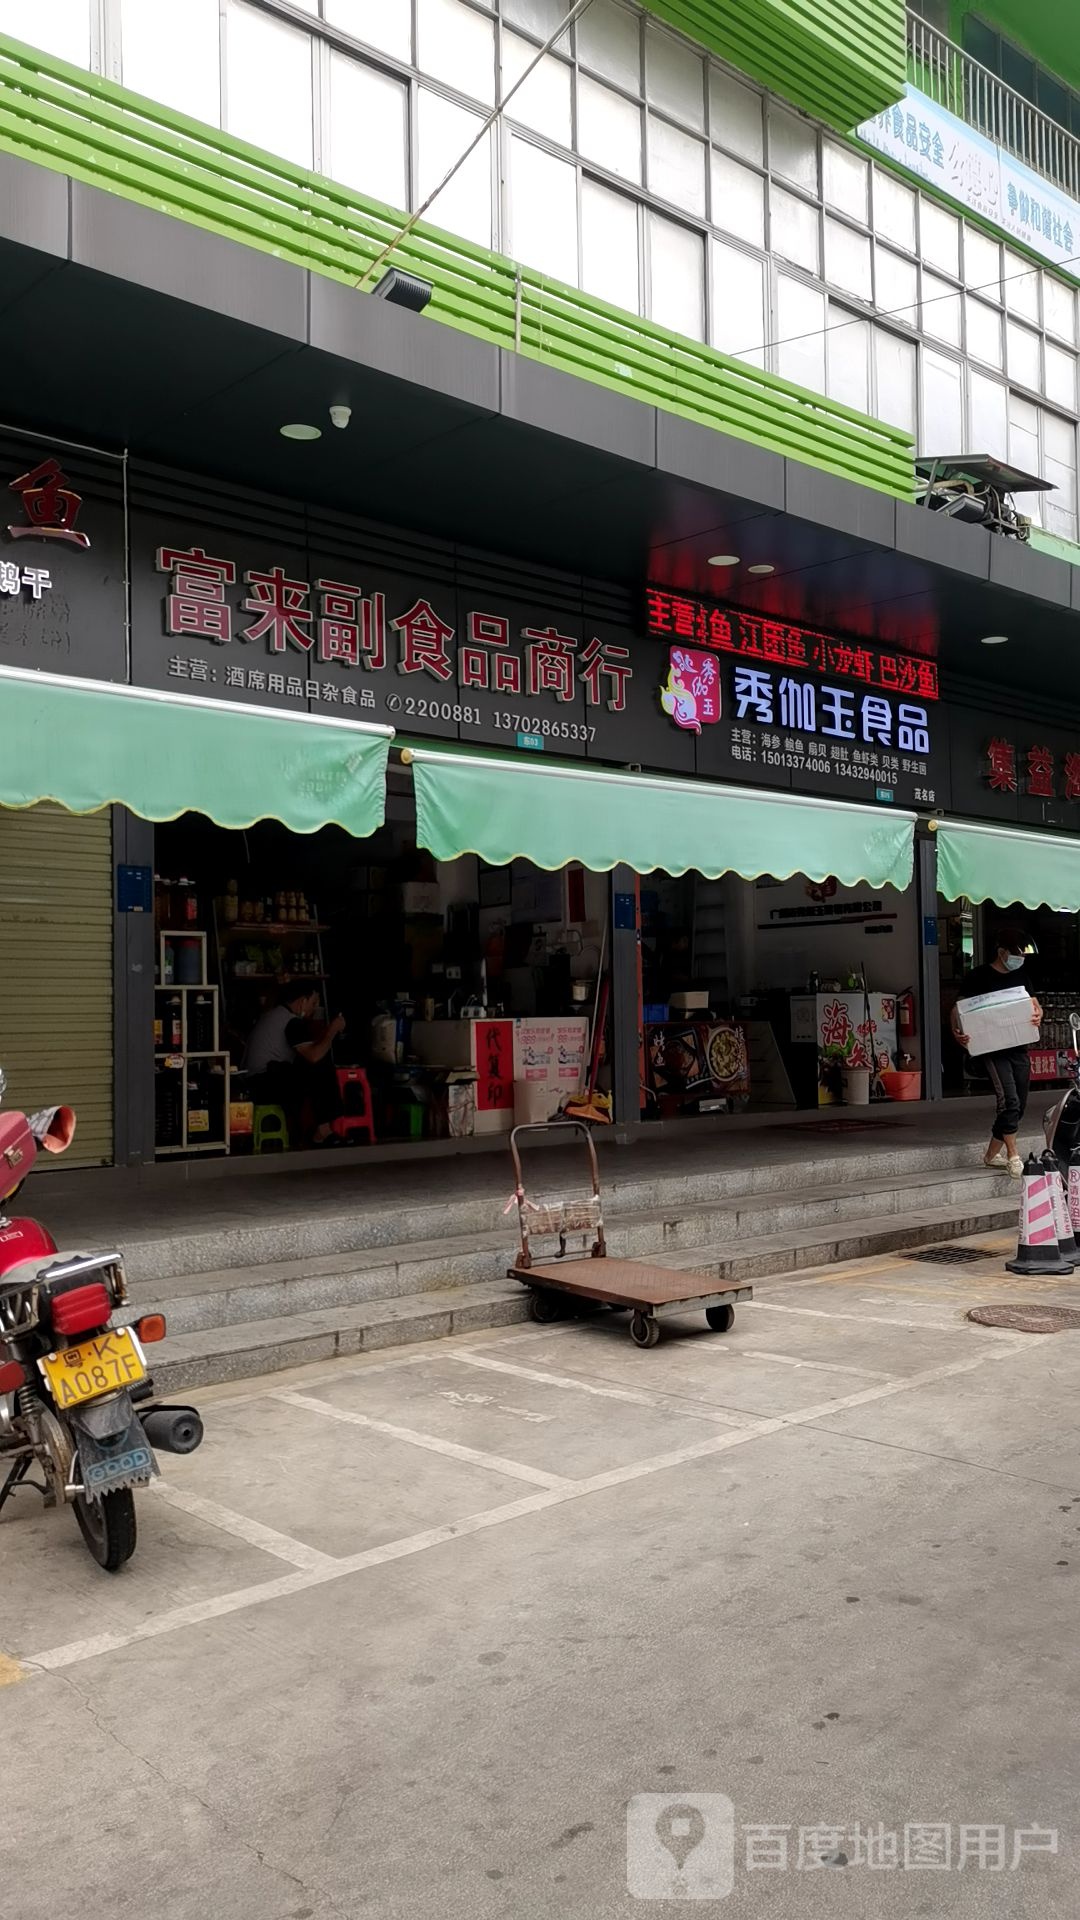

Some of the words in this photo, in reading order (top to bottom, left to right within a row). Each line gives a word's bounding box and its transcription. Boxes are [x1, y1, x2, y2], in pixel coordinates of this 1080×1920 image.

[156, 547, 633, 711] 富来副食品商行
[812, 638, 875, 684] 小龙虾
[879, 654, 936, 698] 巴沙鱼
[405, 697, 482, 725] 2200881
[493, 711, 597, 742] 13702865337
[734, 666, 930, 753] 秀伽玉食品
[784, 737, 805, 755] 鲍鱼
[808, 741, 827, 758] 扇贝
[852, 749, 879, 767] 鱼虾类
[881, 755, 900, 771] 贝类
[834, 762, 898, 785] 13432940015
[913, 787, 936, 803] 茂名店
[61, 1353, 137, 1404] A087F
